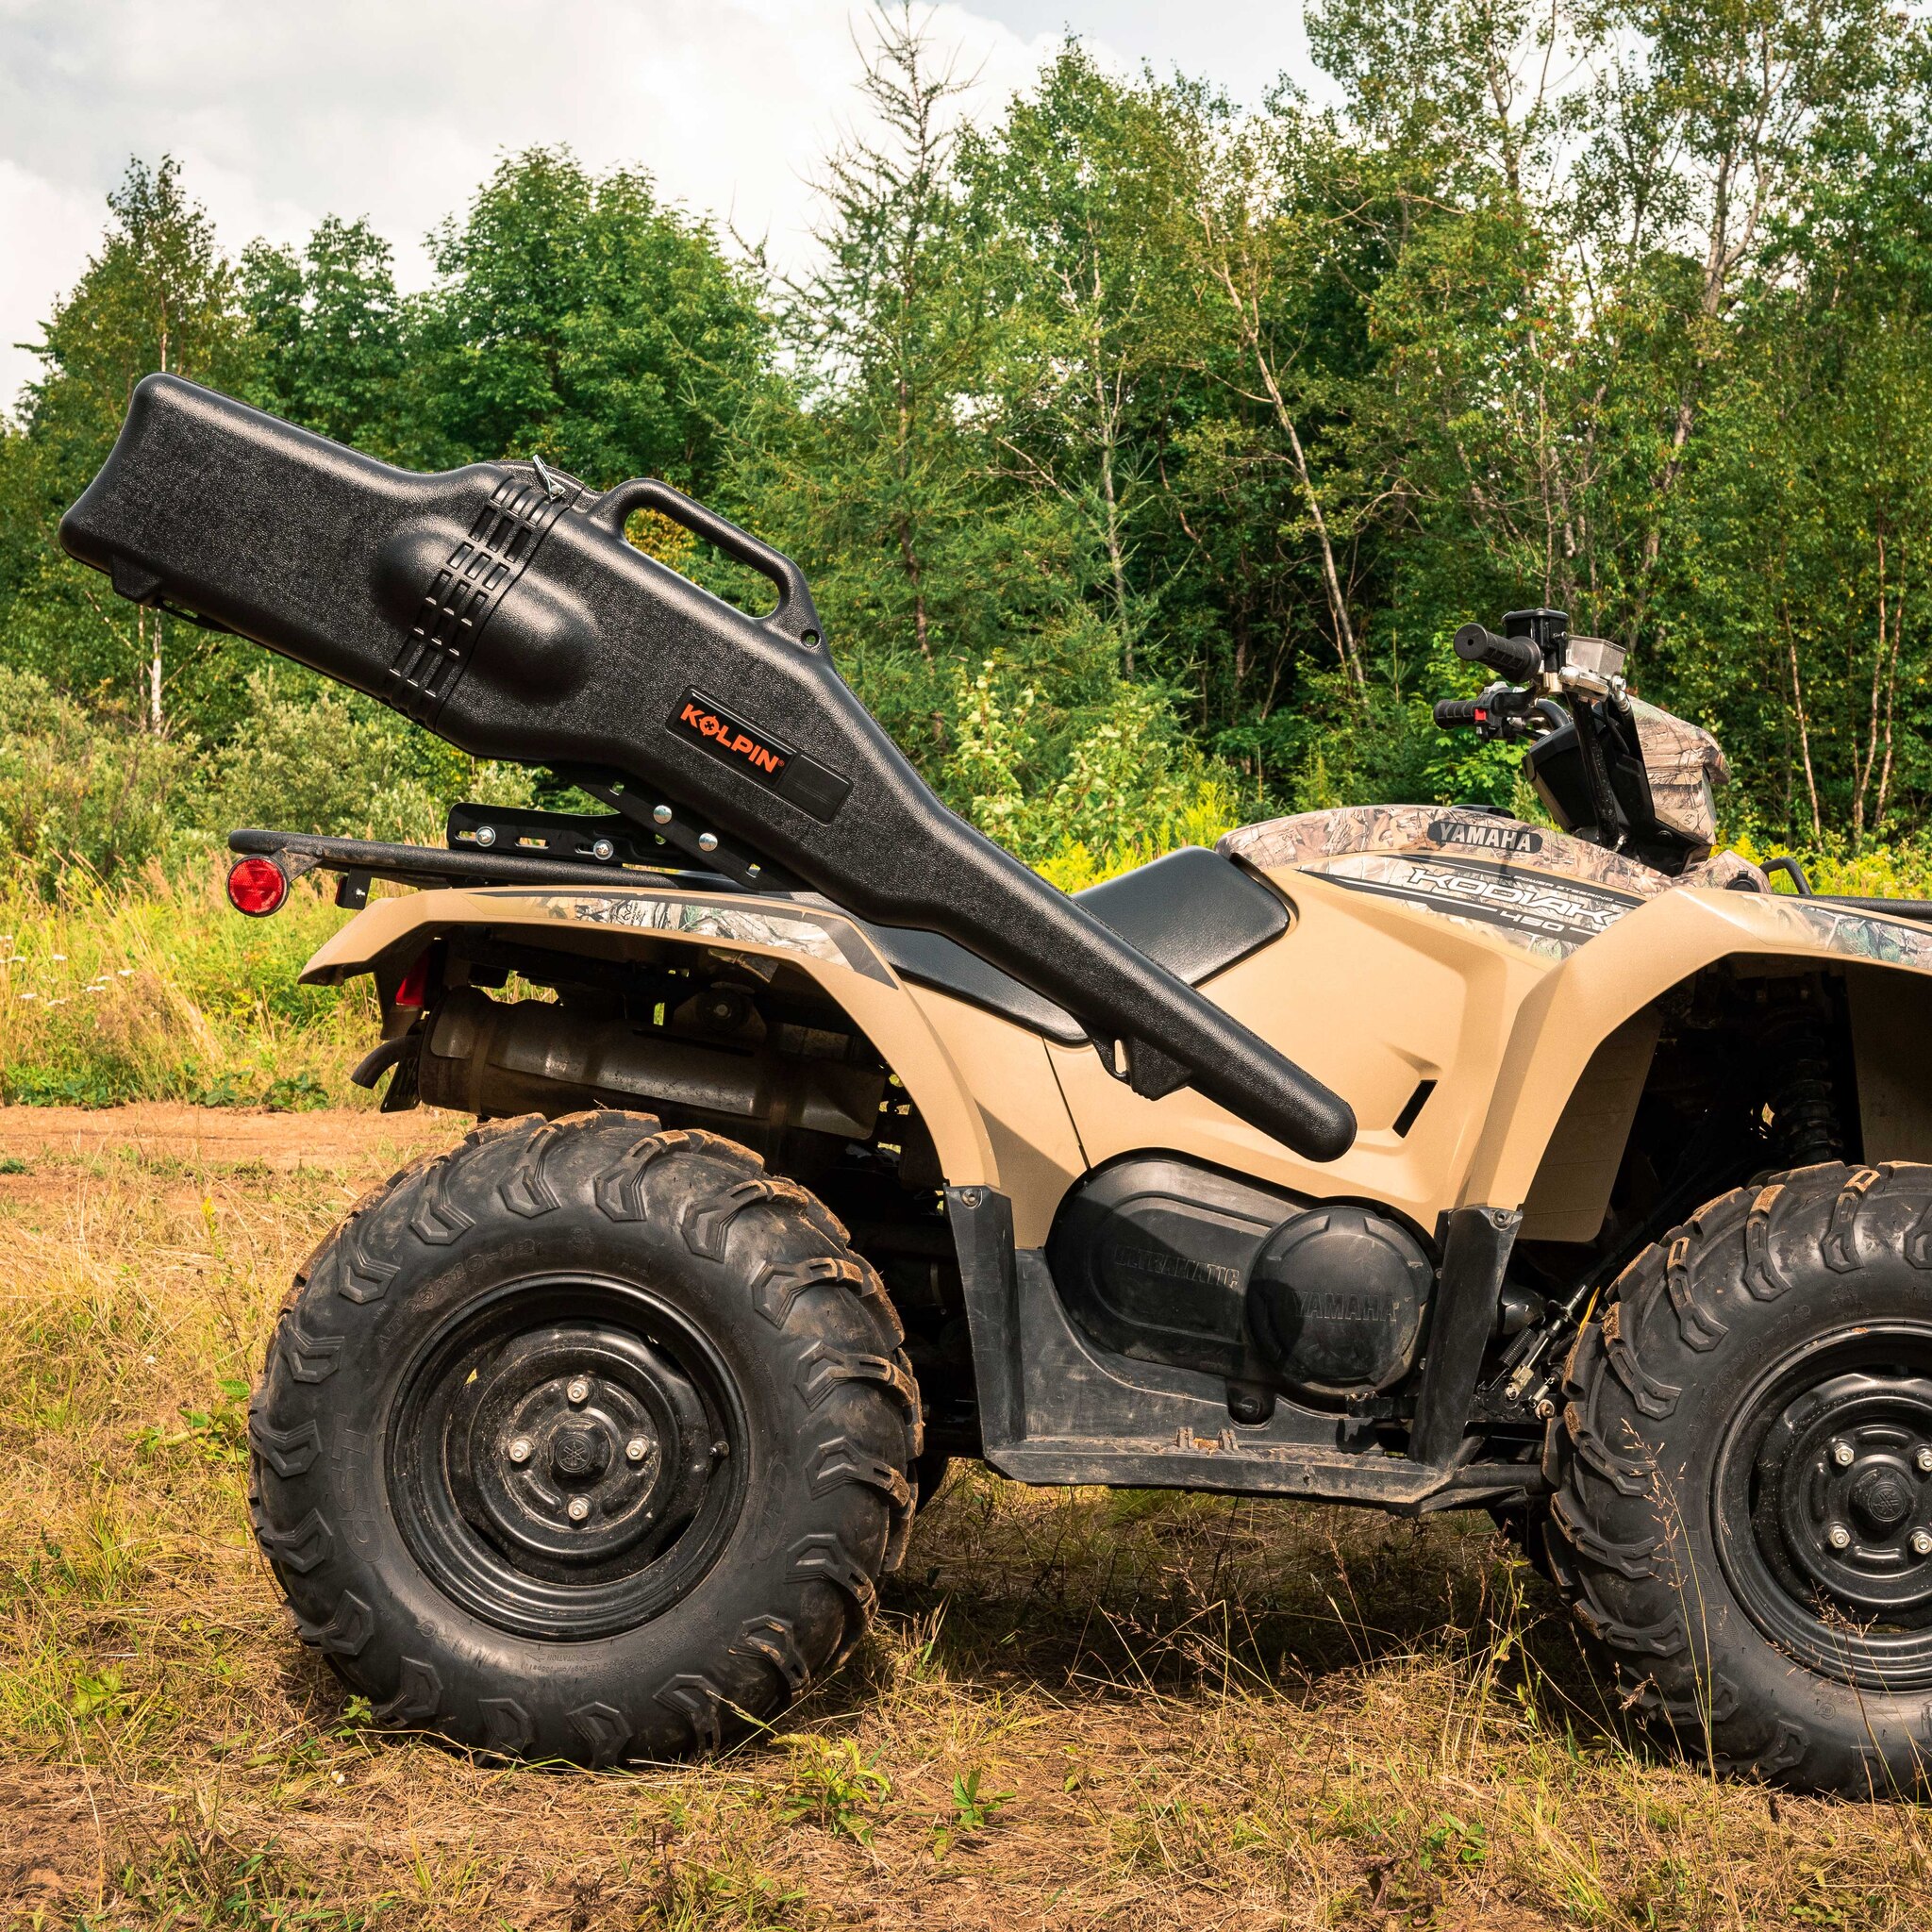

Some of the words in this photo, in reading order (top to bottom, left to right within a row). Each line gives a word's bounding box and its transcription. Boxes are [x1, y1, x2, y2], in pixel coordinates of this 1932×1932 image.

[1440, 823, 1531, 852] YAMAHA
[1407, 867, 1619, 926] KODIAK
[1513, 874, 1555, 888] POWER
[1556, 885, 1615, 902] STEERING
[1500, 911, 1565, 932] 450
[1113, 1244, 1241, 1289] ULTRAMATIC
[1292, 1291, 1397, 1322] YAMAHA
[331, 1412, 383, 1562] CST
